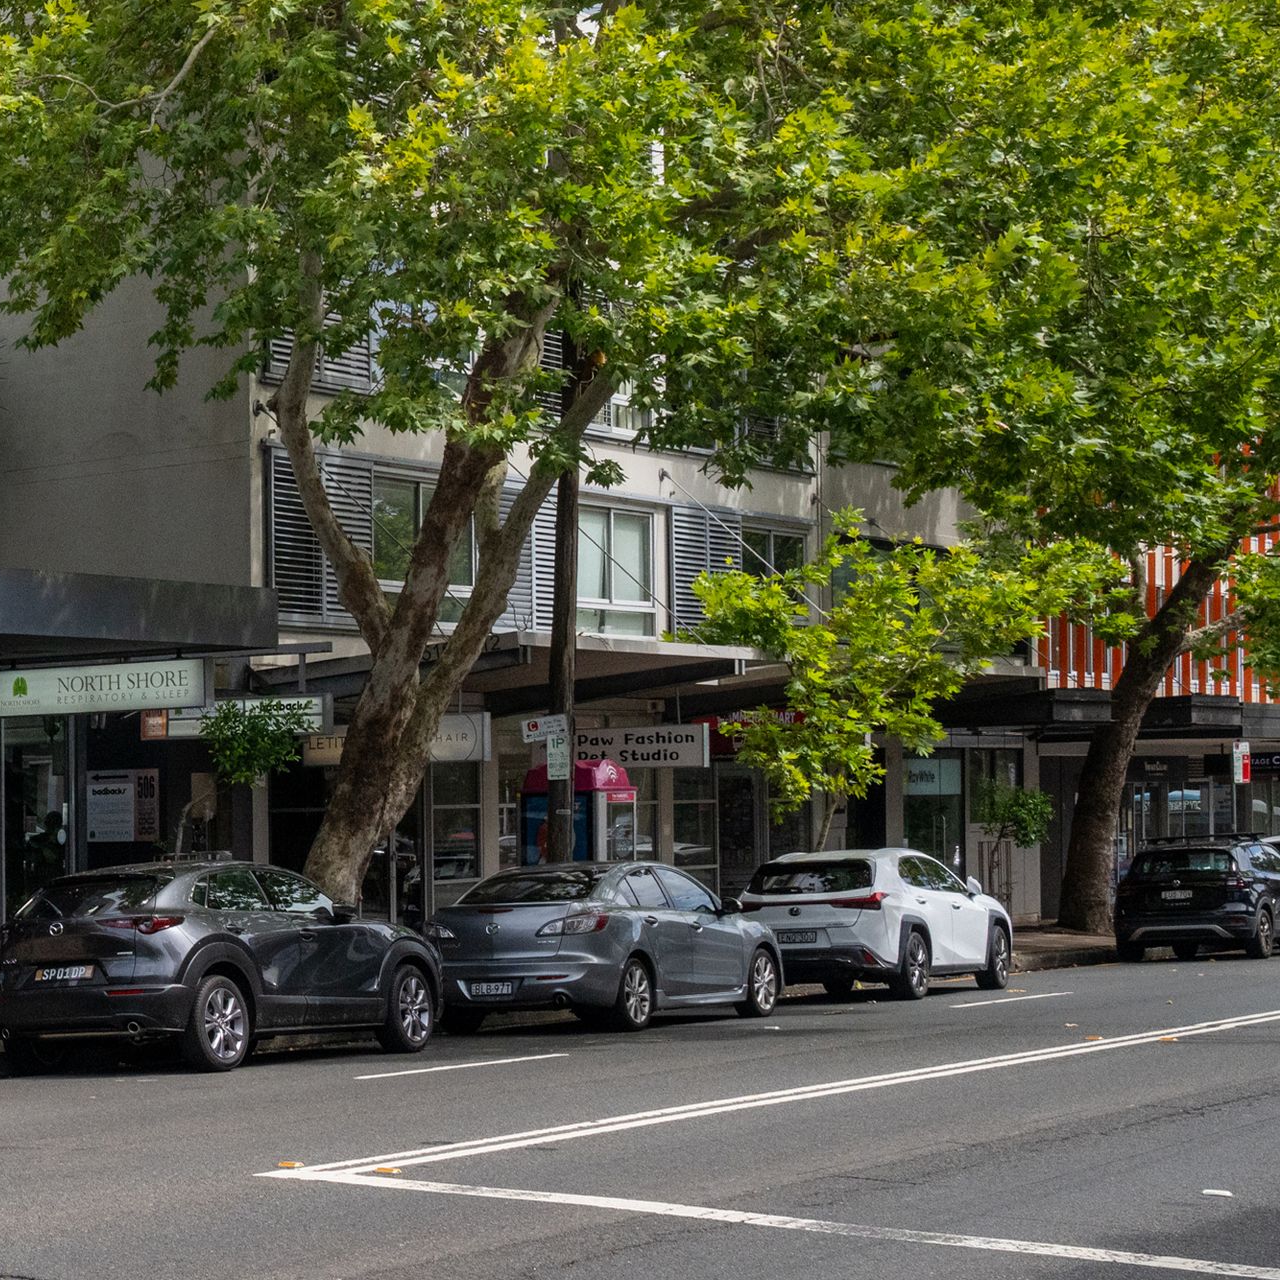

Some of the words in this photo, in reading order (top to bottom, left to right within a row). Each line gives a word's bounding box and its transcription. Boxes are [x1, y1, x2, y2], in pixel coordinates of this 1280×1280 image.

[57, 673, 120, 693] NORTH
[127, 670, 188, 689] SHORE
[57, 692, 134, 705] RESPIRATORY
[141, 691, 147, 700] &
[155, 688, 189, 699] SLEEP
[435, 733, 469, 742] HAIR
[551, 738, 565, 748] 1P
[578, 734, 614, 746] Paw
[624, 732, 695, 745] Fashion
[619, 749, 680, 762] Studio
[138, 775, 155, 799] 506
